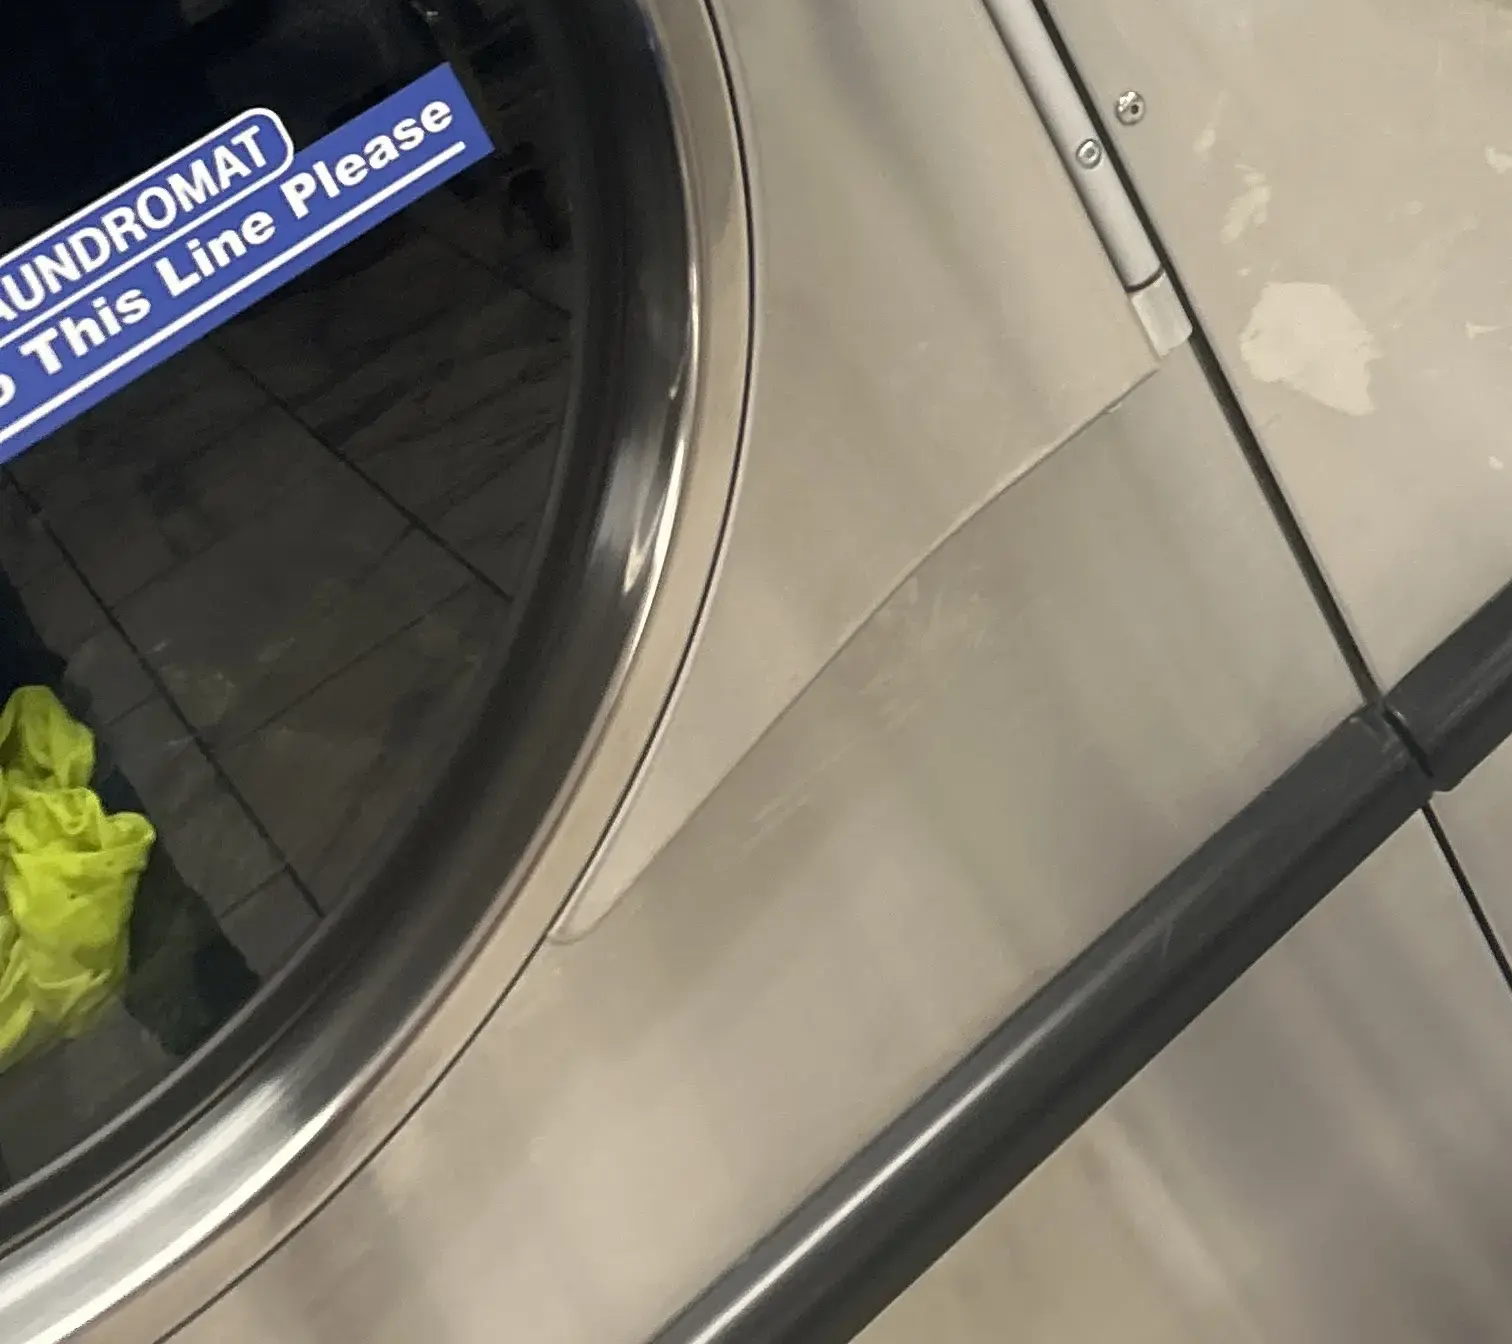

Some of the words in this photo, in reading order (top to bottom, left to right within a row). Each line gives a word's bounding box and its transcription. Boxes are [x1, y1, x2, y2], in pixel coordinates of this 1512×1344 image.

[18, 286, 152, 376] This
[155, 209, 277, 297] Line
[280, 98, 453, 221] Please
